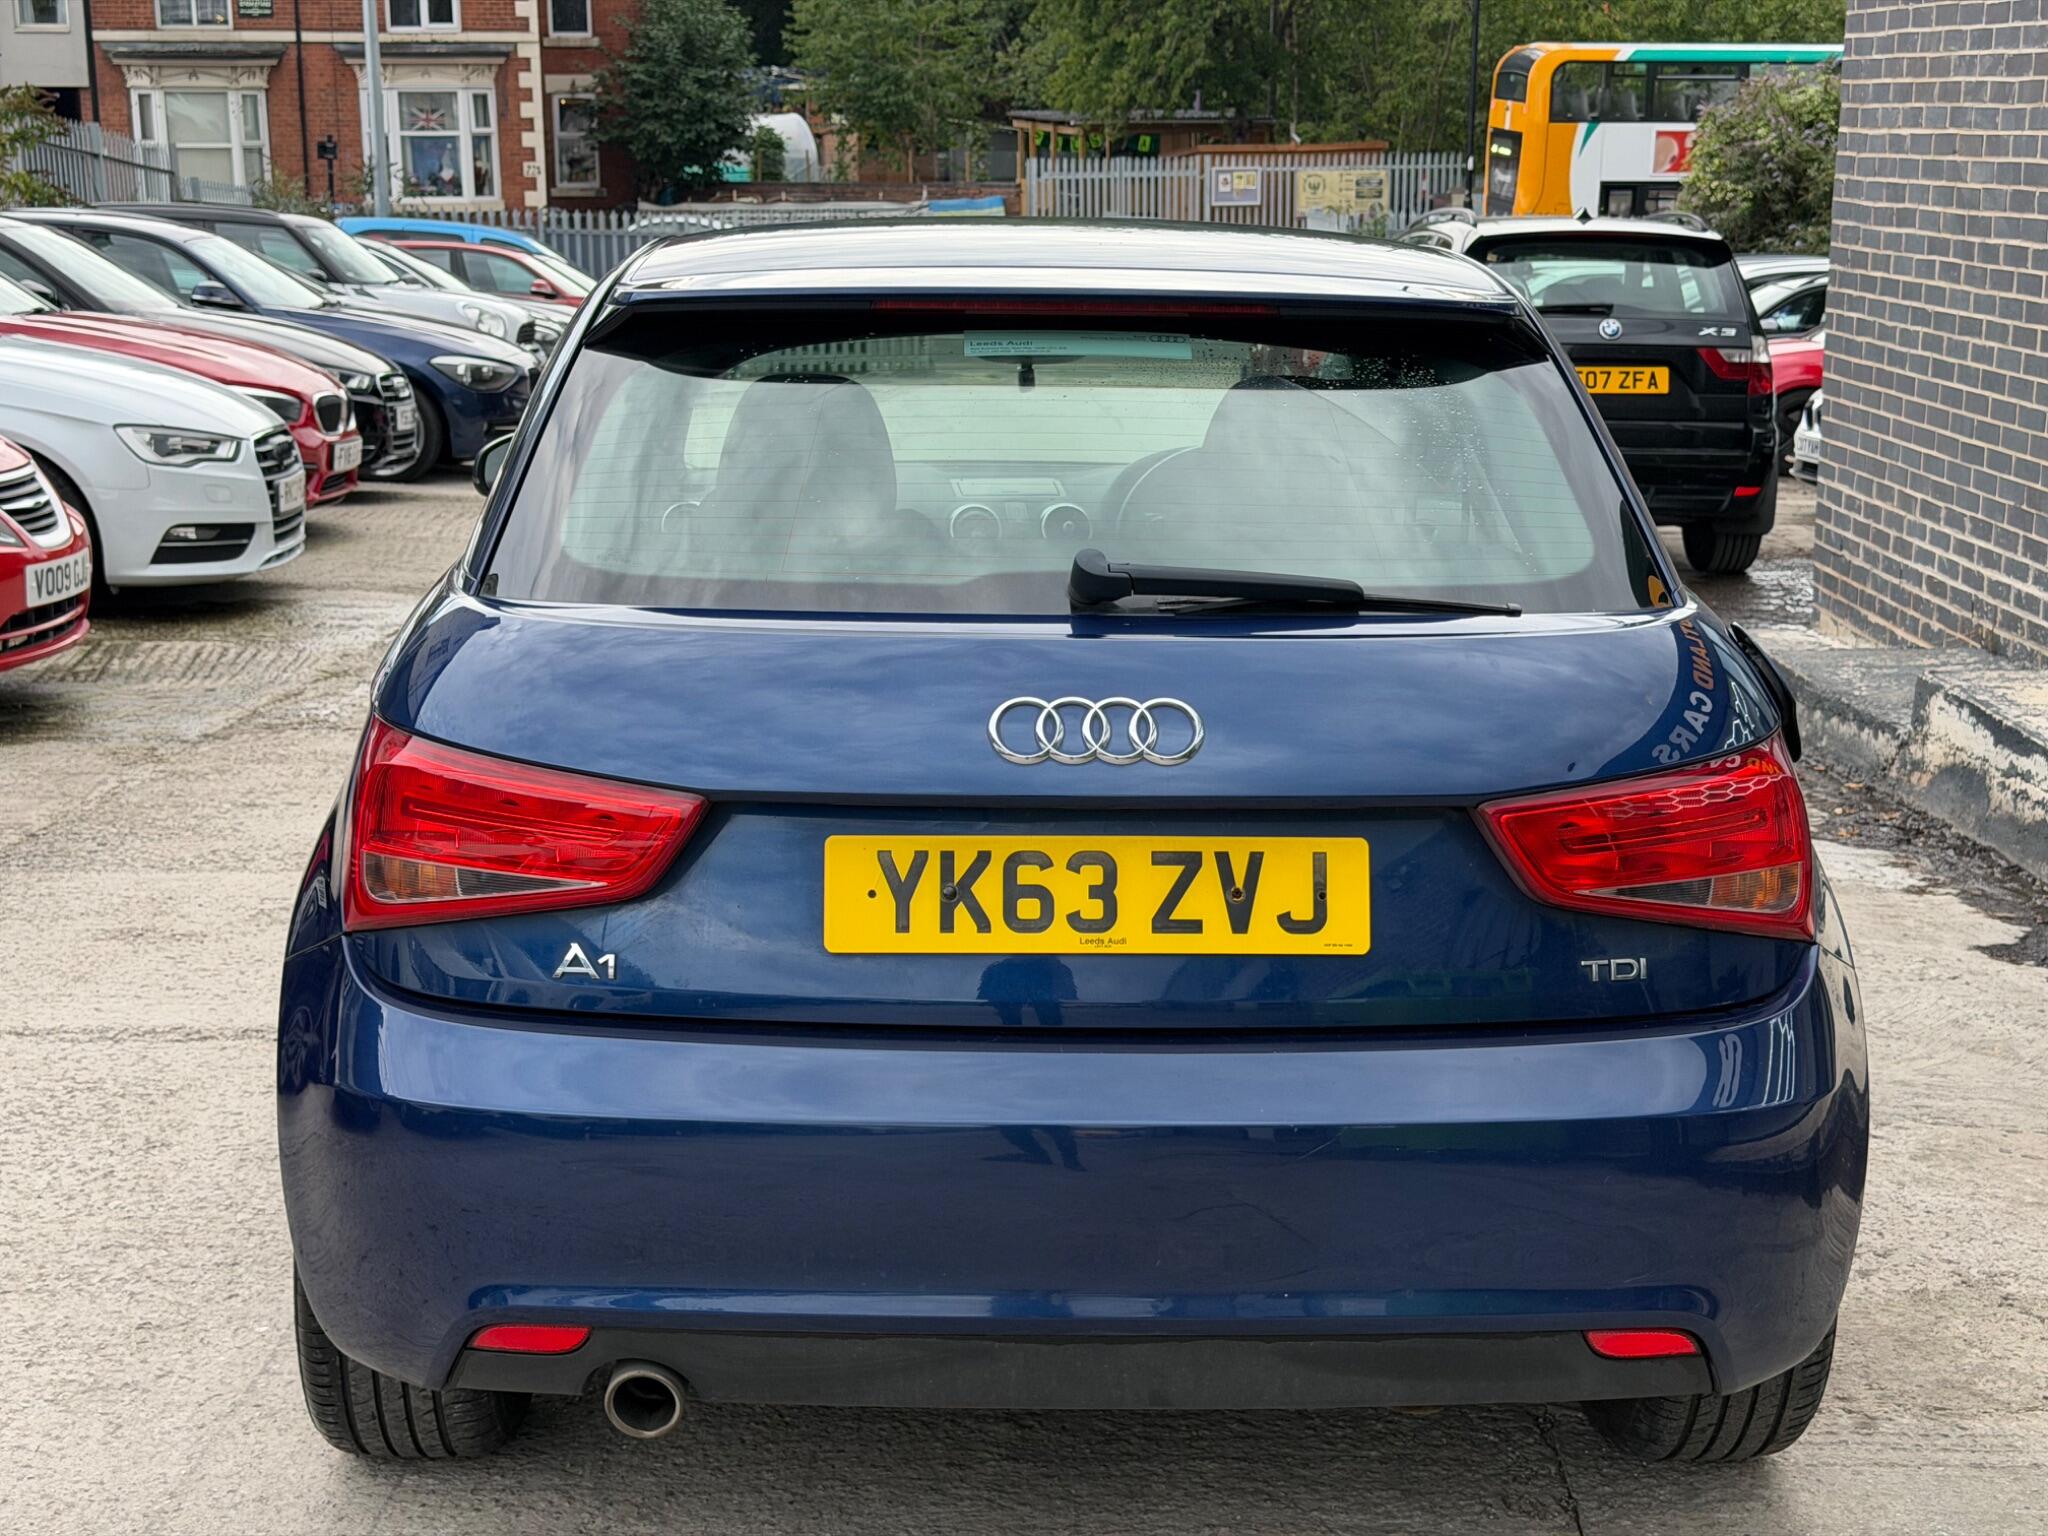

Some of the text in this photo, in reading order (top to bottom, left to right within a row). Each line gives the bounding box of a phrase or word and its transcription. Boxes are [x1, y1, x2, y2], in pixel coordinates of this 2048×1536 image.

[1698, 327, 1737, 337] X3
[1006, 339, 1034, 347] Audi
[1576, 370, 1659, 389] 07 ZFA
[876, 849, 1329, 935] YK63 ZVJ
[1079, 936, 1128, 945] Leeds Audi
[552, 942, 616, 980] A1
[1580, 957, 1647, 982] TDI
